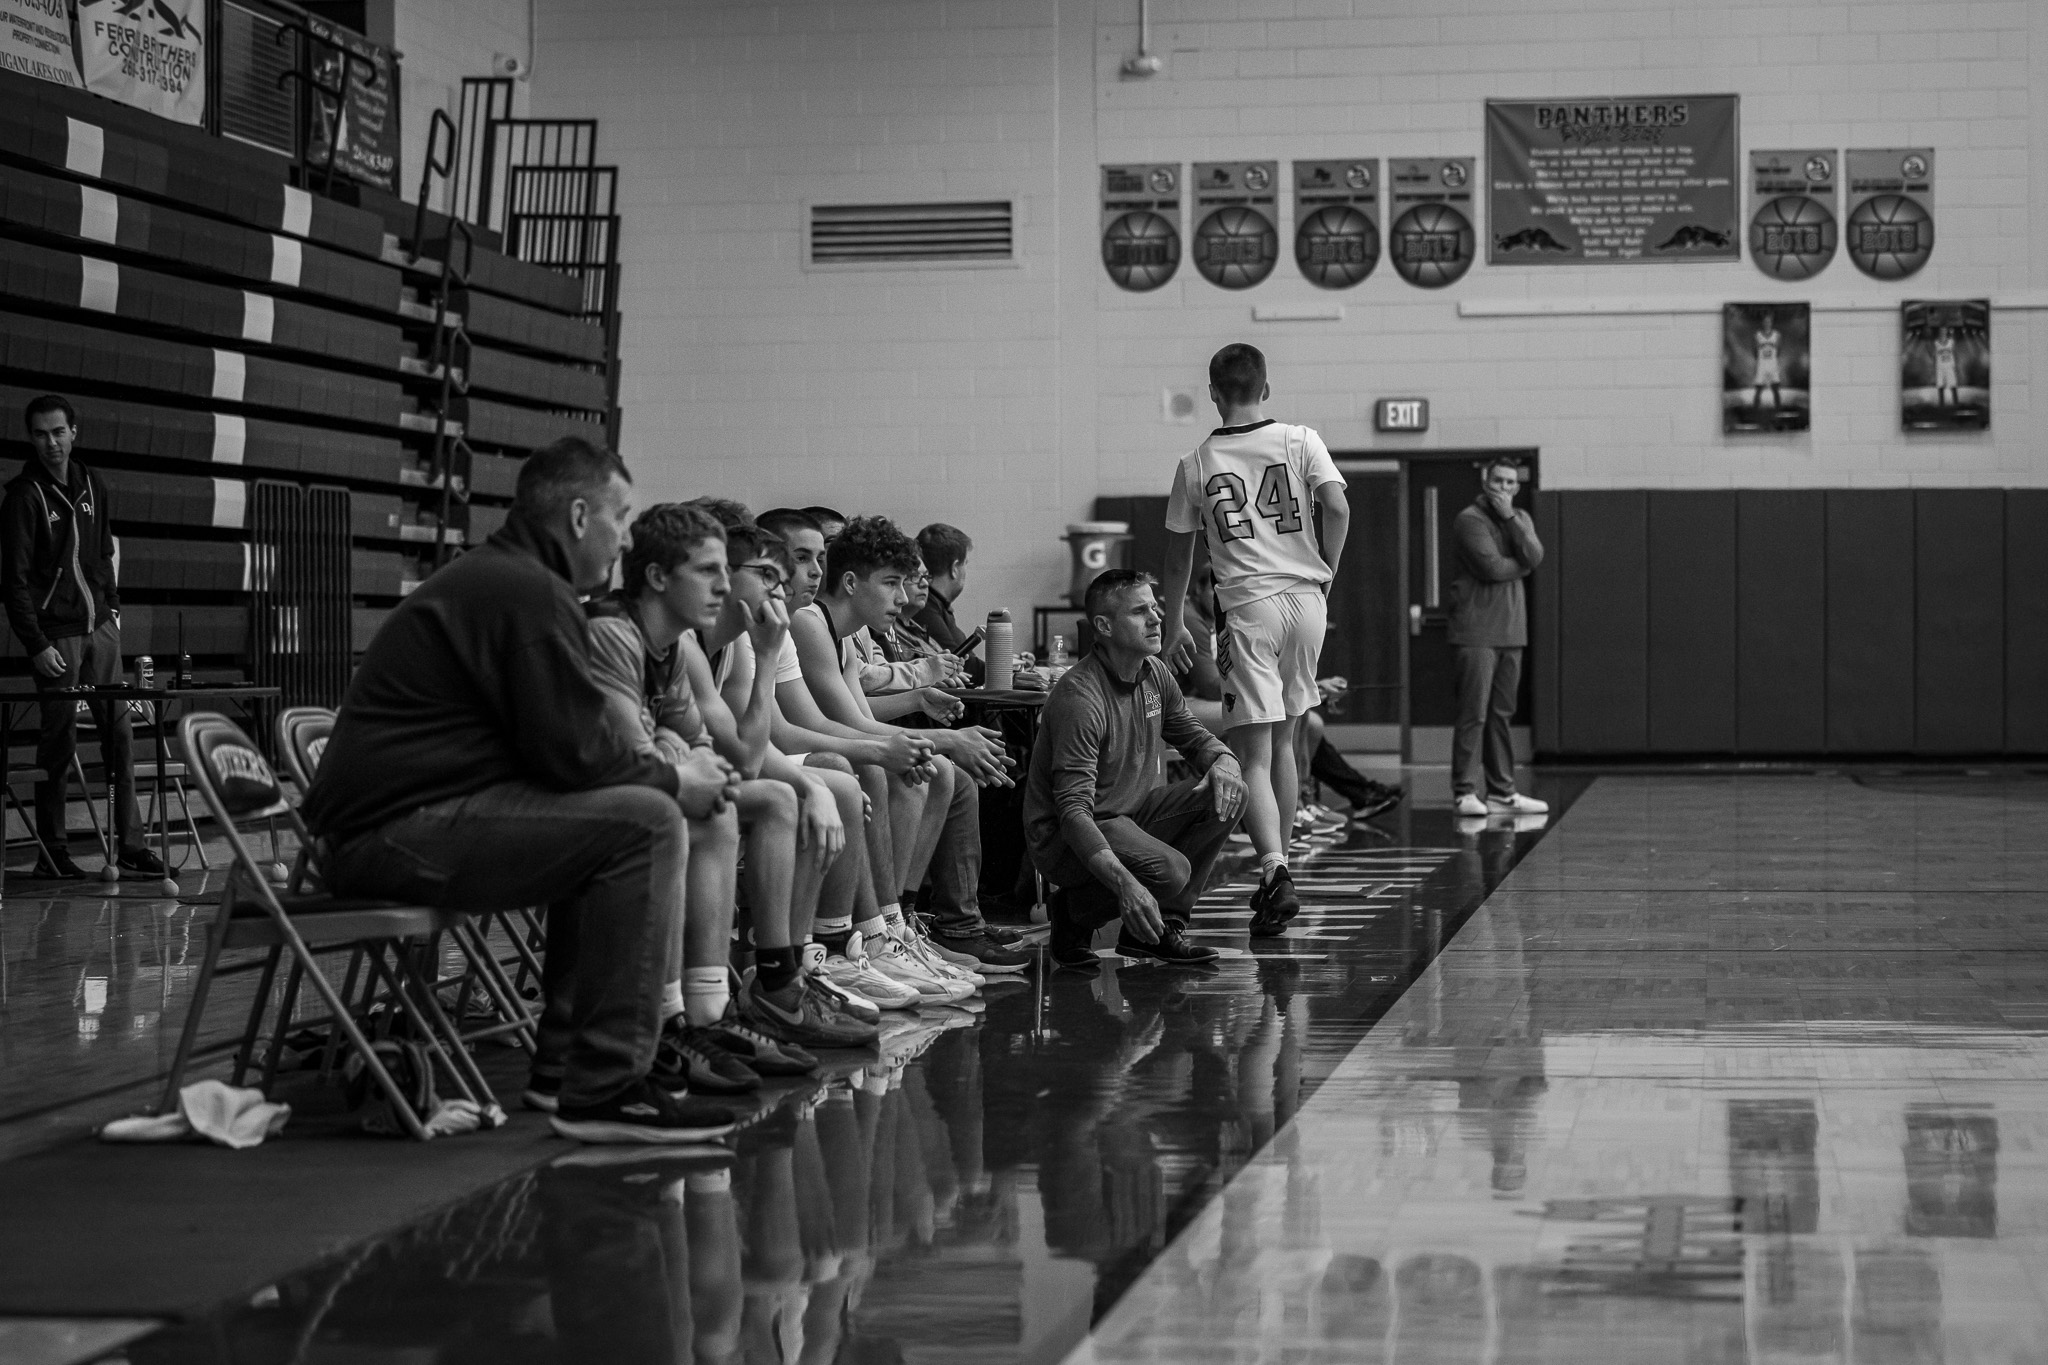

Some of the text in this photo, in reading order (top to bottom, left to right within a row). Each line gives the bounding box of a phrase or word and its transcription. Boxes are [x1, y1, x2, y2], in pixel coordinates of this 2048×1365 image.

[1535, 104, 1687, 127] PANTHERS
[1406, 241, 1457, 261] 2017
[1767, 232, 1819, 250] 2018
[1386, 401, 1422, 427] EXIT
[1205, 463, 1302, 543] 24
[1082, 541, 1107, 569] G
